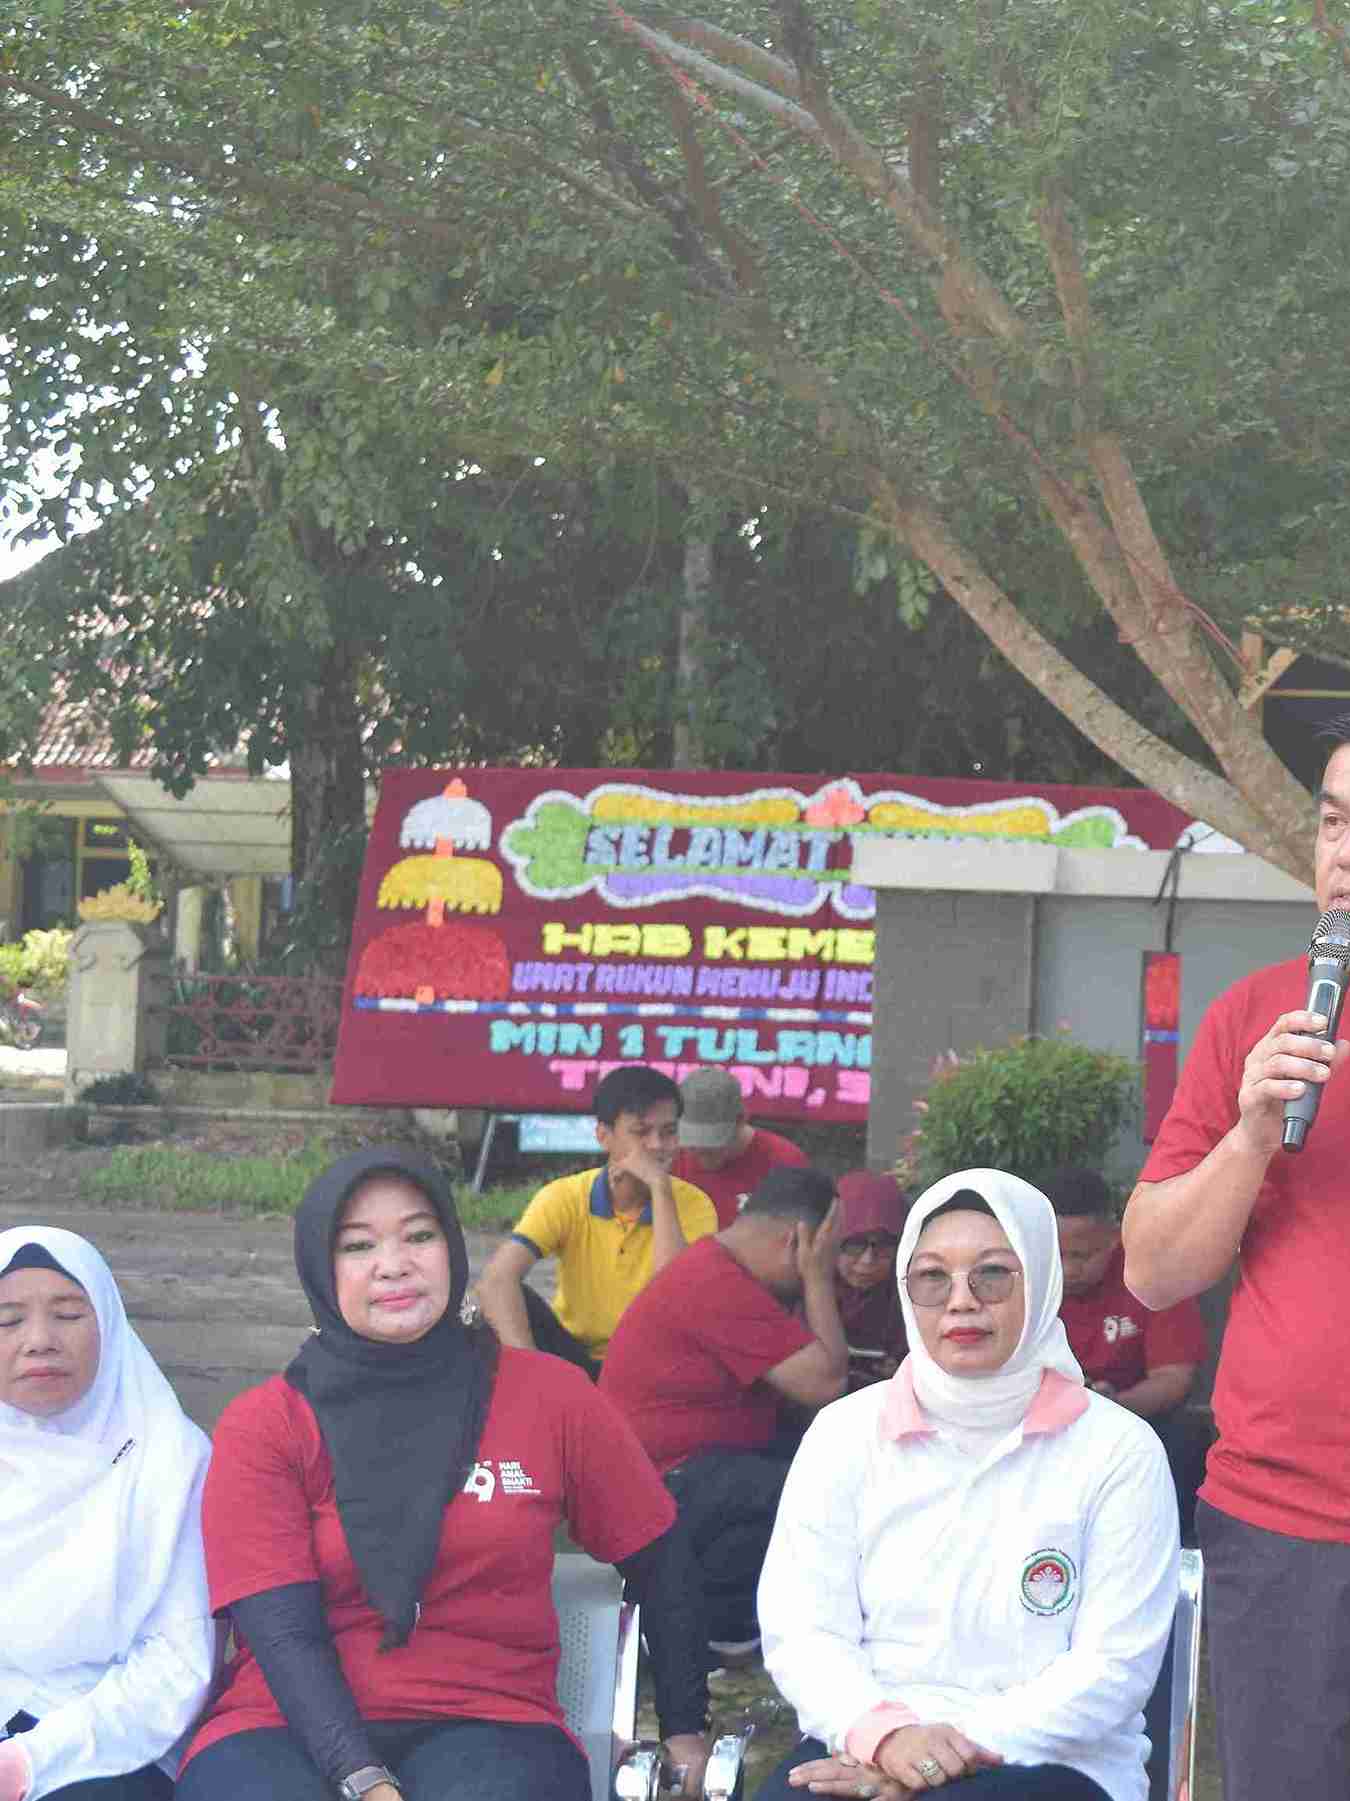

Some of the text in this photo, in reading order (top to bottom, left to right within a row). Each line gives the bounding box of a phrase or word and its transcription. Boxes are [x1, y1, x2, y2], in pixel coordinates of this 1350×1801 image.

[585, 824, 844, 871] SELAMAT
[542, 922, 693, 957] HAB
[490, 1020, 602, 1056] MIN
[618, 1024, 645, 1057] 1
